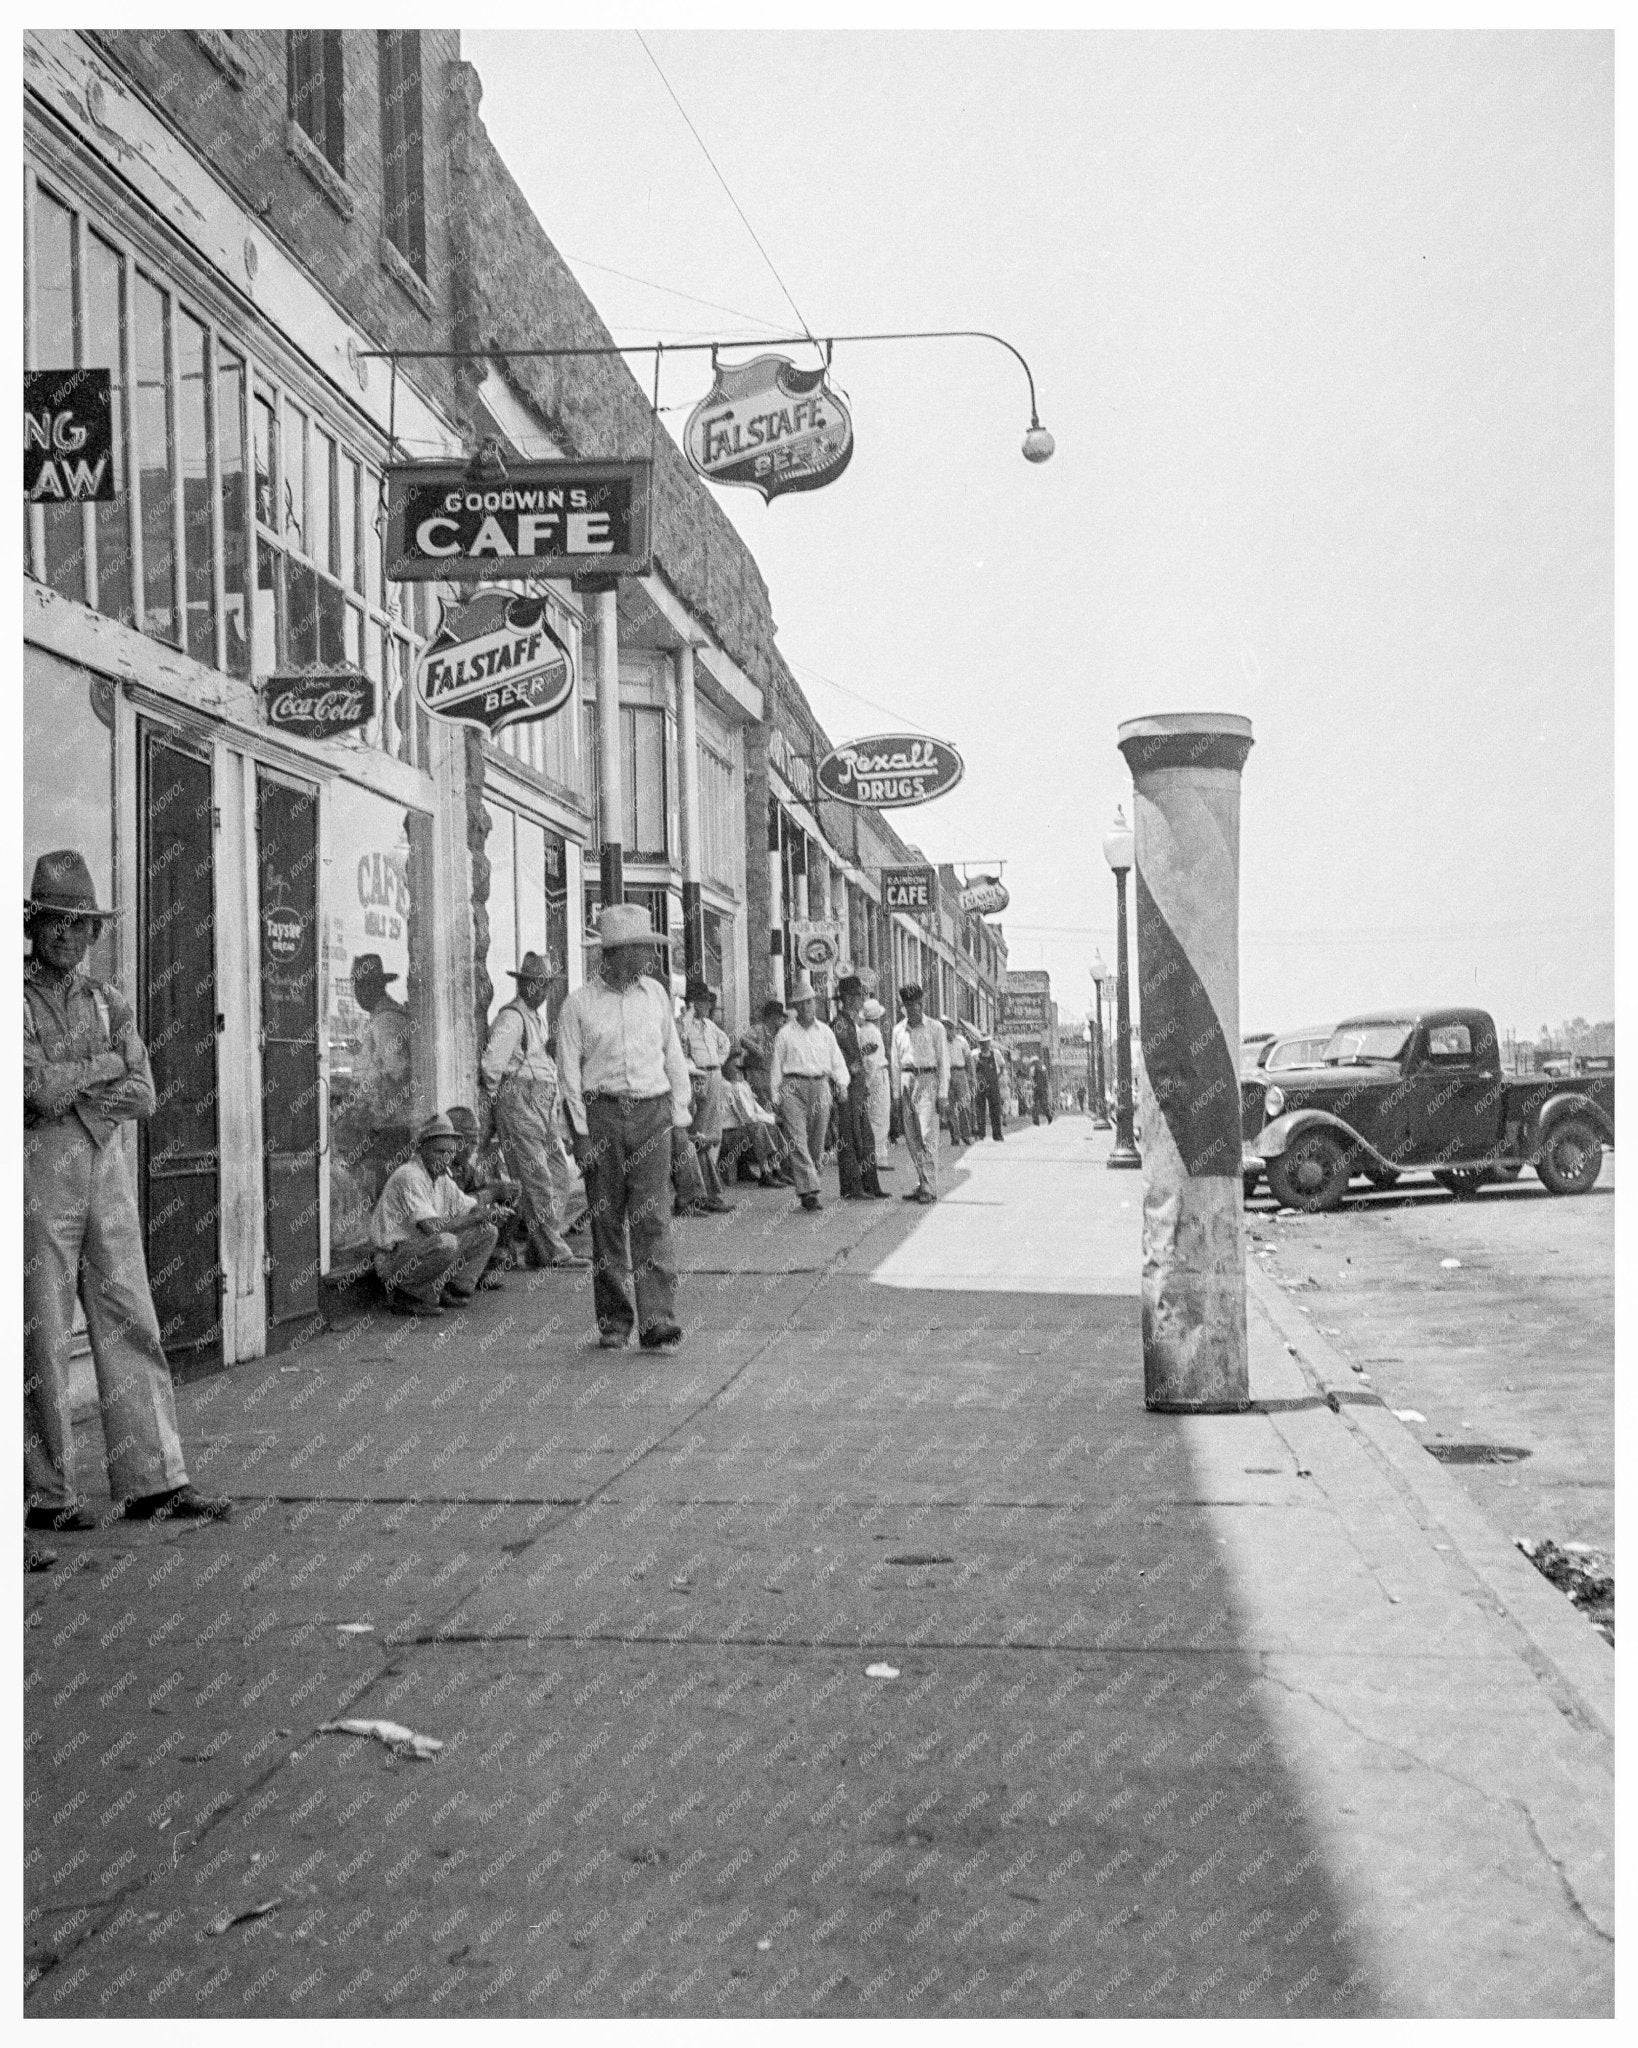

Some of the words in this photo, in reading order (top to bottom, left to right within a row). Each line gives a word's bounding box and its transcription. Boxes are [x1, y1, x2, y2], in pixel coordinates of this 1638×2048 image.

[702, 398, 826, 464] FALSTAFF
[24, 459, 106, 498] AW
[416, 511, 615, 557] CAFE
[425, 635, 542, 699] FALSTAFF
[484, 676, 546, 713] BEER
[836, 742, 938, 784] Rexall
[857, 778, 926, 800] DRUGS
[887, 885, 928, 906] CAFE
